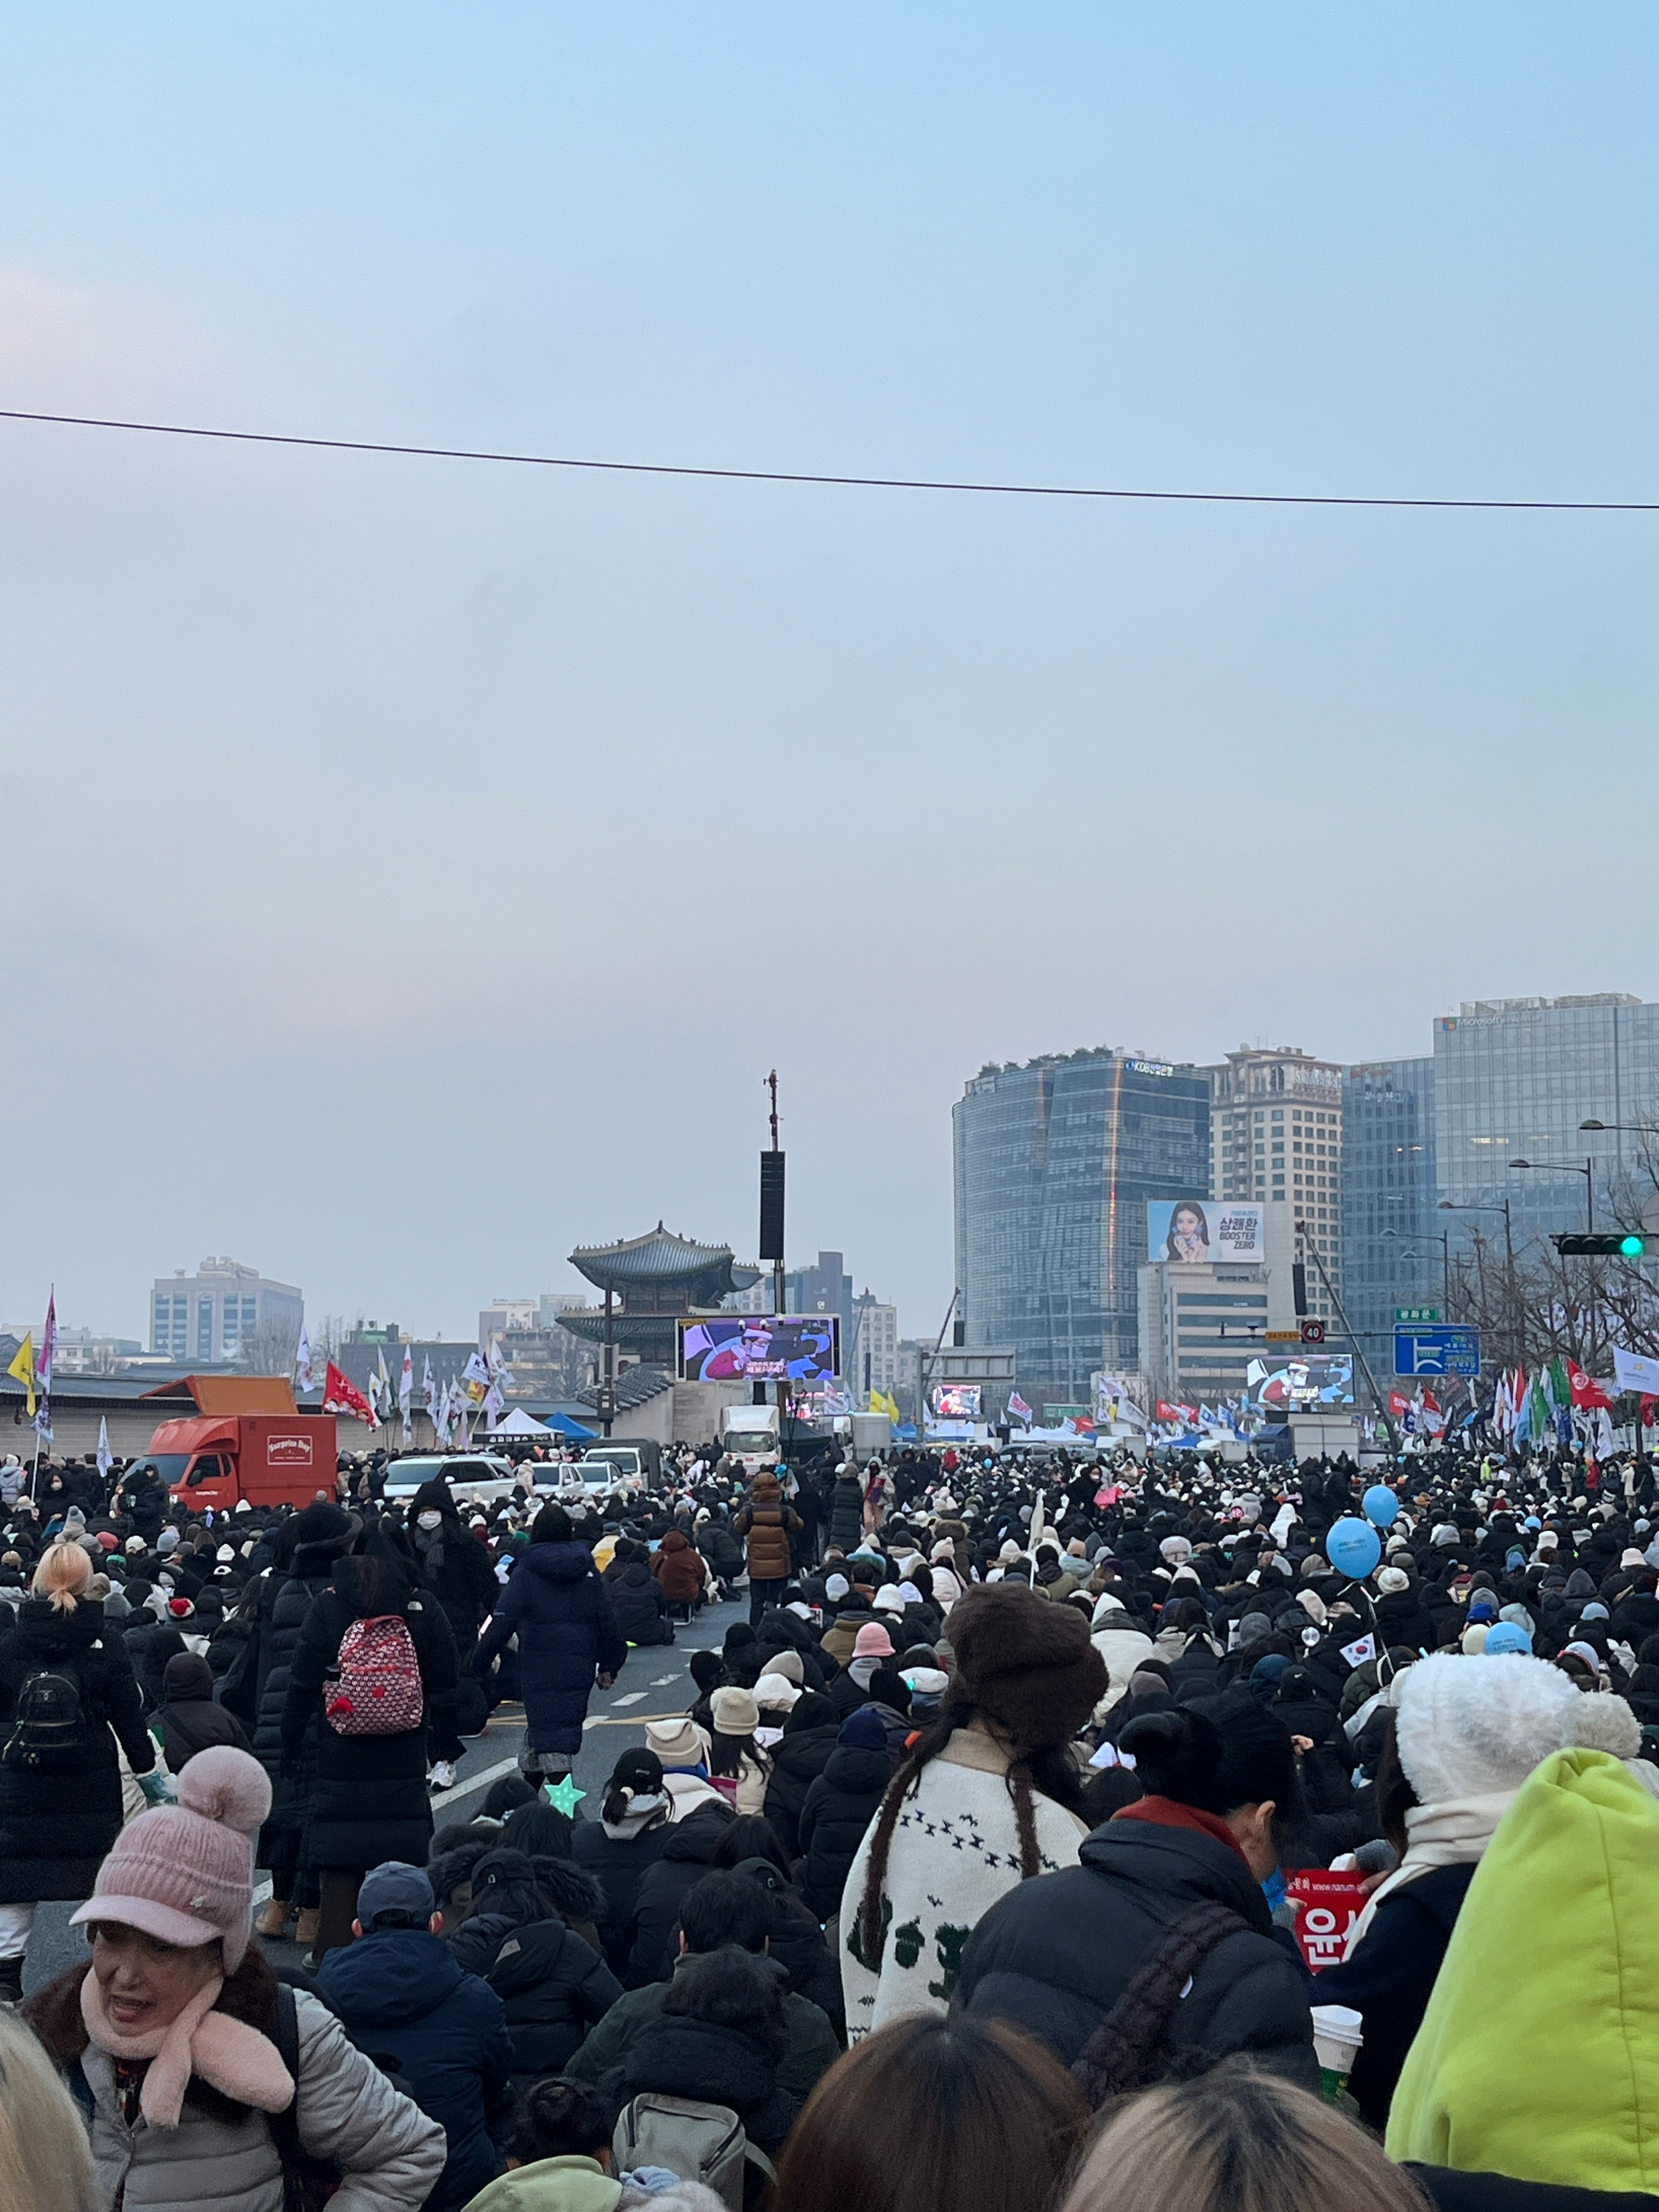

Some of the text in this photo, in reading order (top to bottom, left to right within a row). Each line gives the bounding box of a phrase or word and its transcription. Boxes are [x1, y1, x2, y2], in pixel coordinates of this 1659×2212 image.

[1219, 1232, 1256, 1240] BOOSTER
[1233, 1240, 1255, 1249] ZERO
[1307, 1328, 1319, 1338] 40
[268, 1439, 311, 1453] Surprise Day
